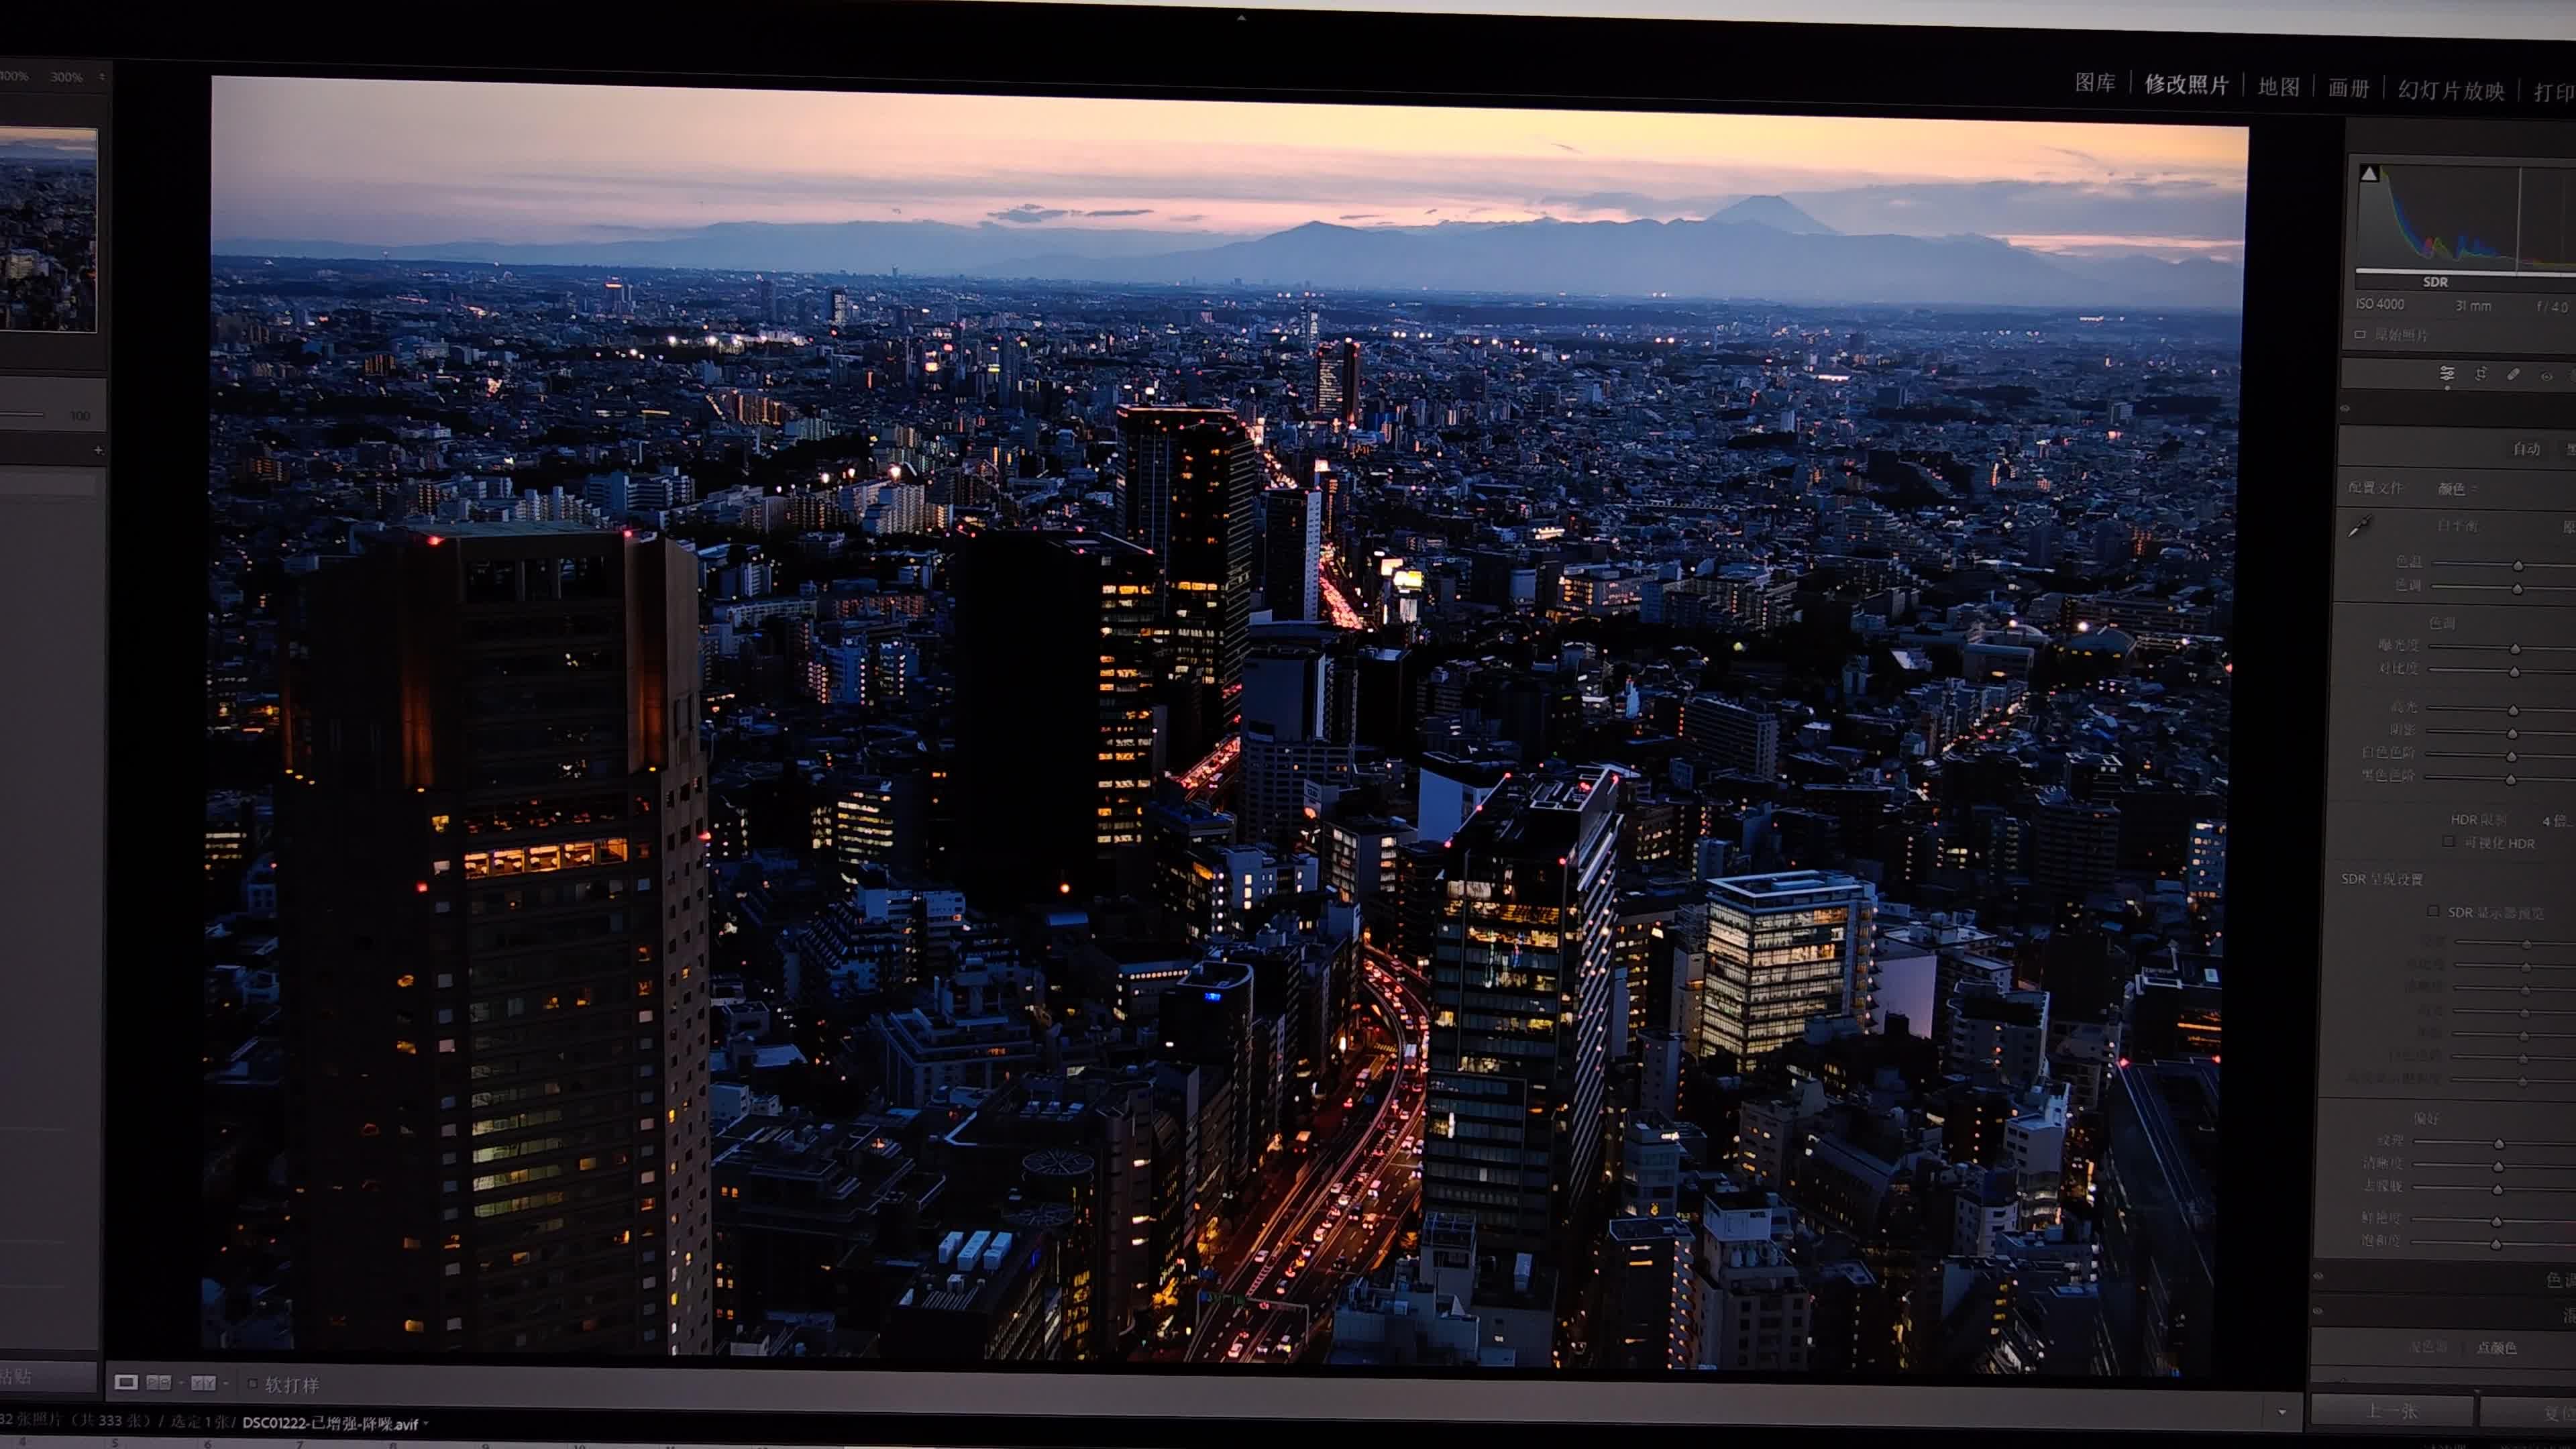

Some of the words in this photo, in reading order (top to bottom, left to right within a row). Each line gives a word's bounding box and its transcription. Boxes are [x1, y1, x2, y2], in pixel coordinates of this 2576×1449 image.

[50, 71, 84, 83] 300%
[2076, 72, 2116, 93] 图库
[2145, 73, 2229, 96] 修改照片
[2259, 75, 2300, 97] 地图
[2329, 77, 2371, 99] 画册
[2398, 79, 2506, 101] 幻灯片放映
[2423, 276, 2449, 288] SDR
[2356, 299, 2373, 309] ISO
[2377, 299, 2405, 310] 4000
[2456, 301, 2467, 311] 31
[2471, 303, 2491, 312] mm
[2513, 441, 2540, 456] 自动
[2348, 480, 2404, 494] 配置文件
[2437, 482, 2466, 496] 颜色
[2361, 745, 2415, 759] 白色色阶
[2451, 814, 2477, 826] HDR
[2508, 838, 2535, 849] HDR
[2341, 873, 2367, 885] SDR
[2448, 908, 2473, 918] SDR
[2477, 1341, 2517, 1355] 点颜色
[266, 1376, 320, 1395] 软打样
[2367, 1402, 2420, 1420] 上一张
[99, 1415, 122, 1427] 333
[242, 1415, 419, 1432] DSC01222-已增强-降噪.avif
